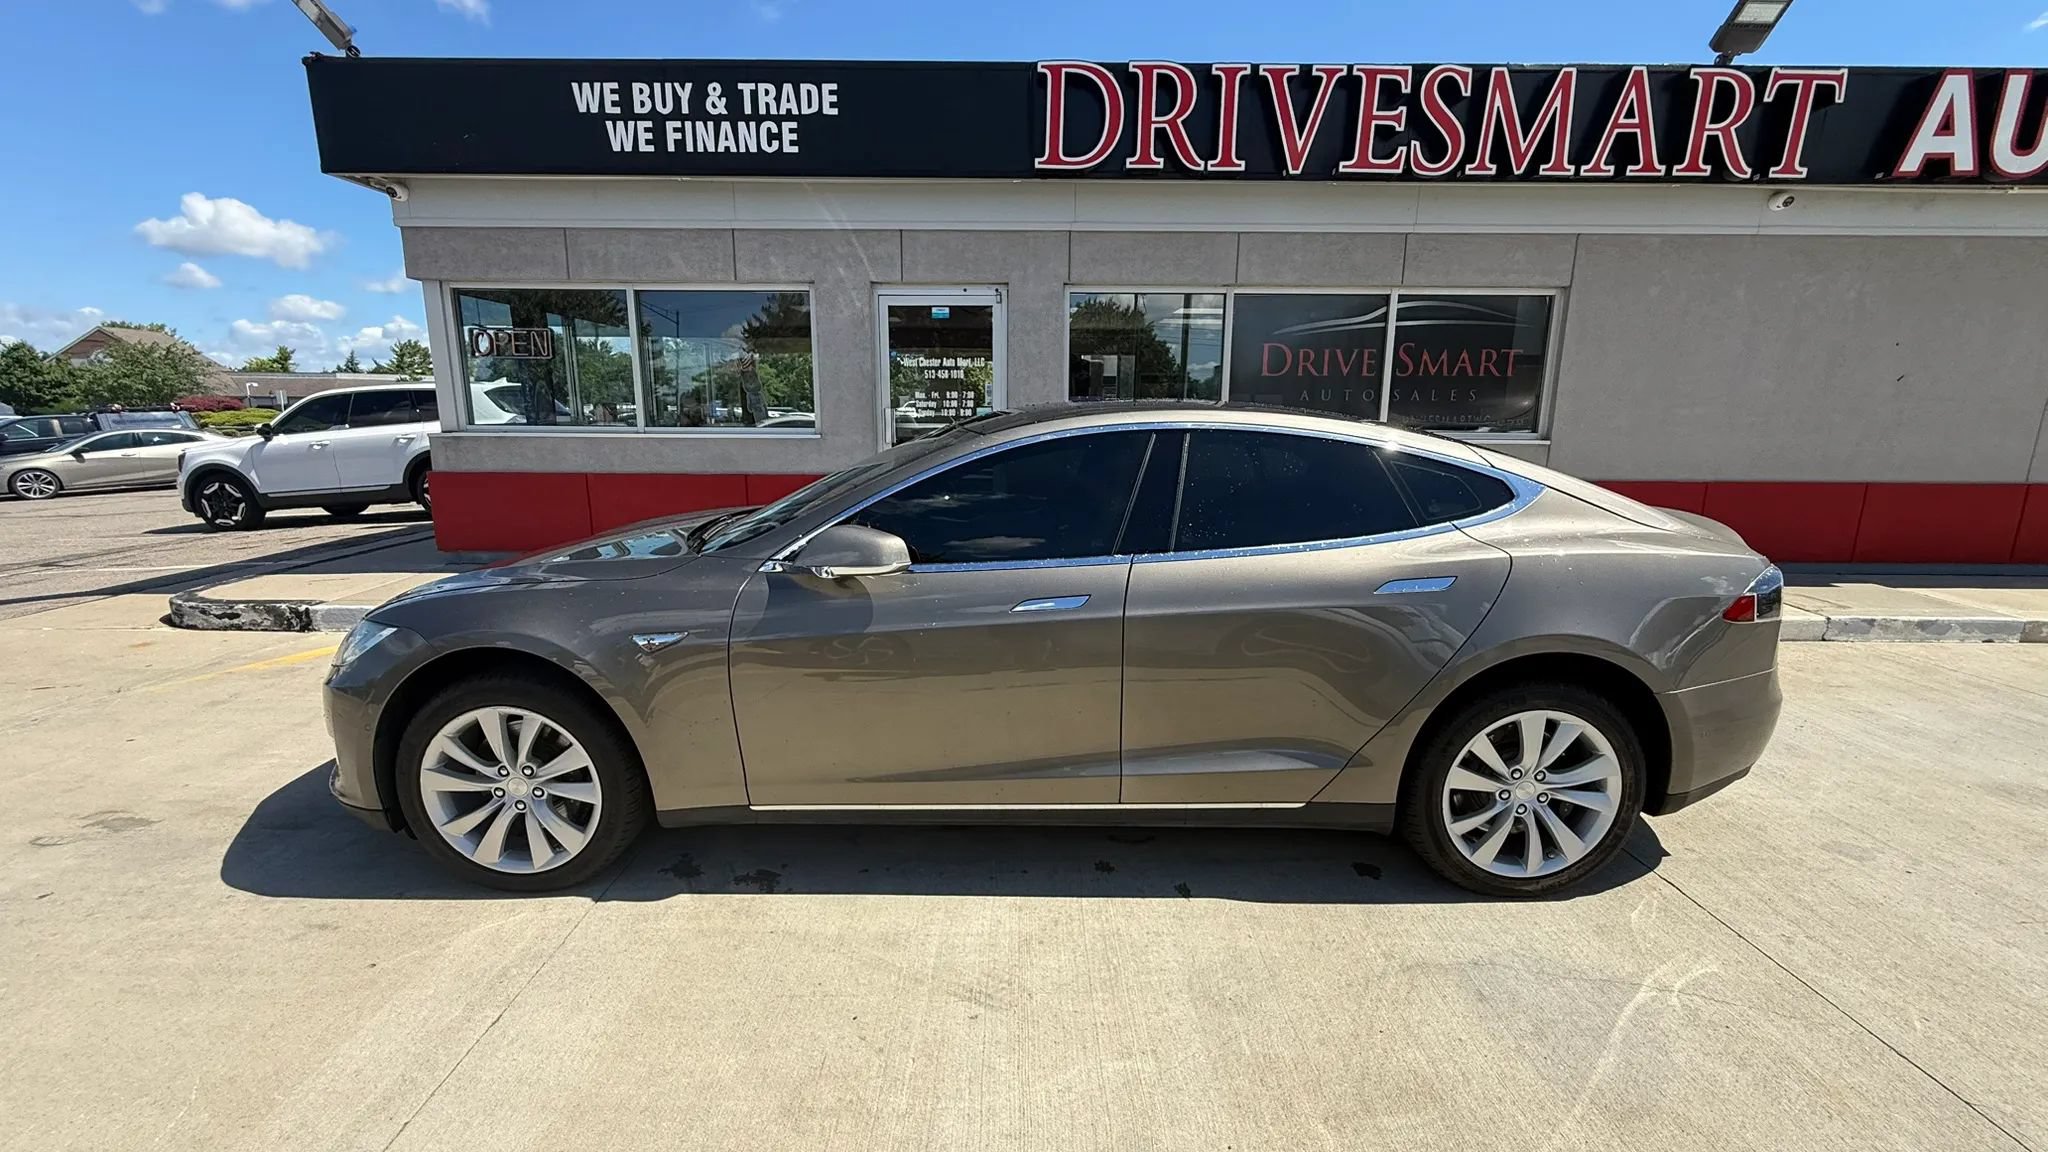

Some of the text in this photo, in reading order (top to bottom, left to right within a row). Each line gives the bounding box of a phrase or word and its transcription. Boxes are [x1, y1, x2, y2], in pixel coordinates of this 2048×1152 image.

[571, 81, 839, 116] WE BUY & TRADE
[1034, 60, 2048, 180] DRIVESMART AU
[605, 120, 800, 153] WE FINANCE
[472, 330, 548, 356] OPEN
[919, 357, 941, 367] Chester
[942, 357, 956, 367] Auto
[1260, 342, 1524, 377] DRIVE SMART
[916, 400, 937, 408] Saturday
[1300, 389, 1478, 401] AUTO SALES
